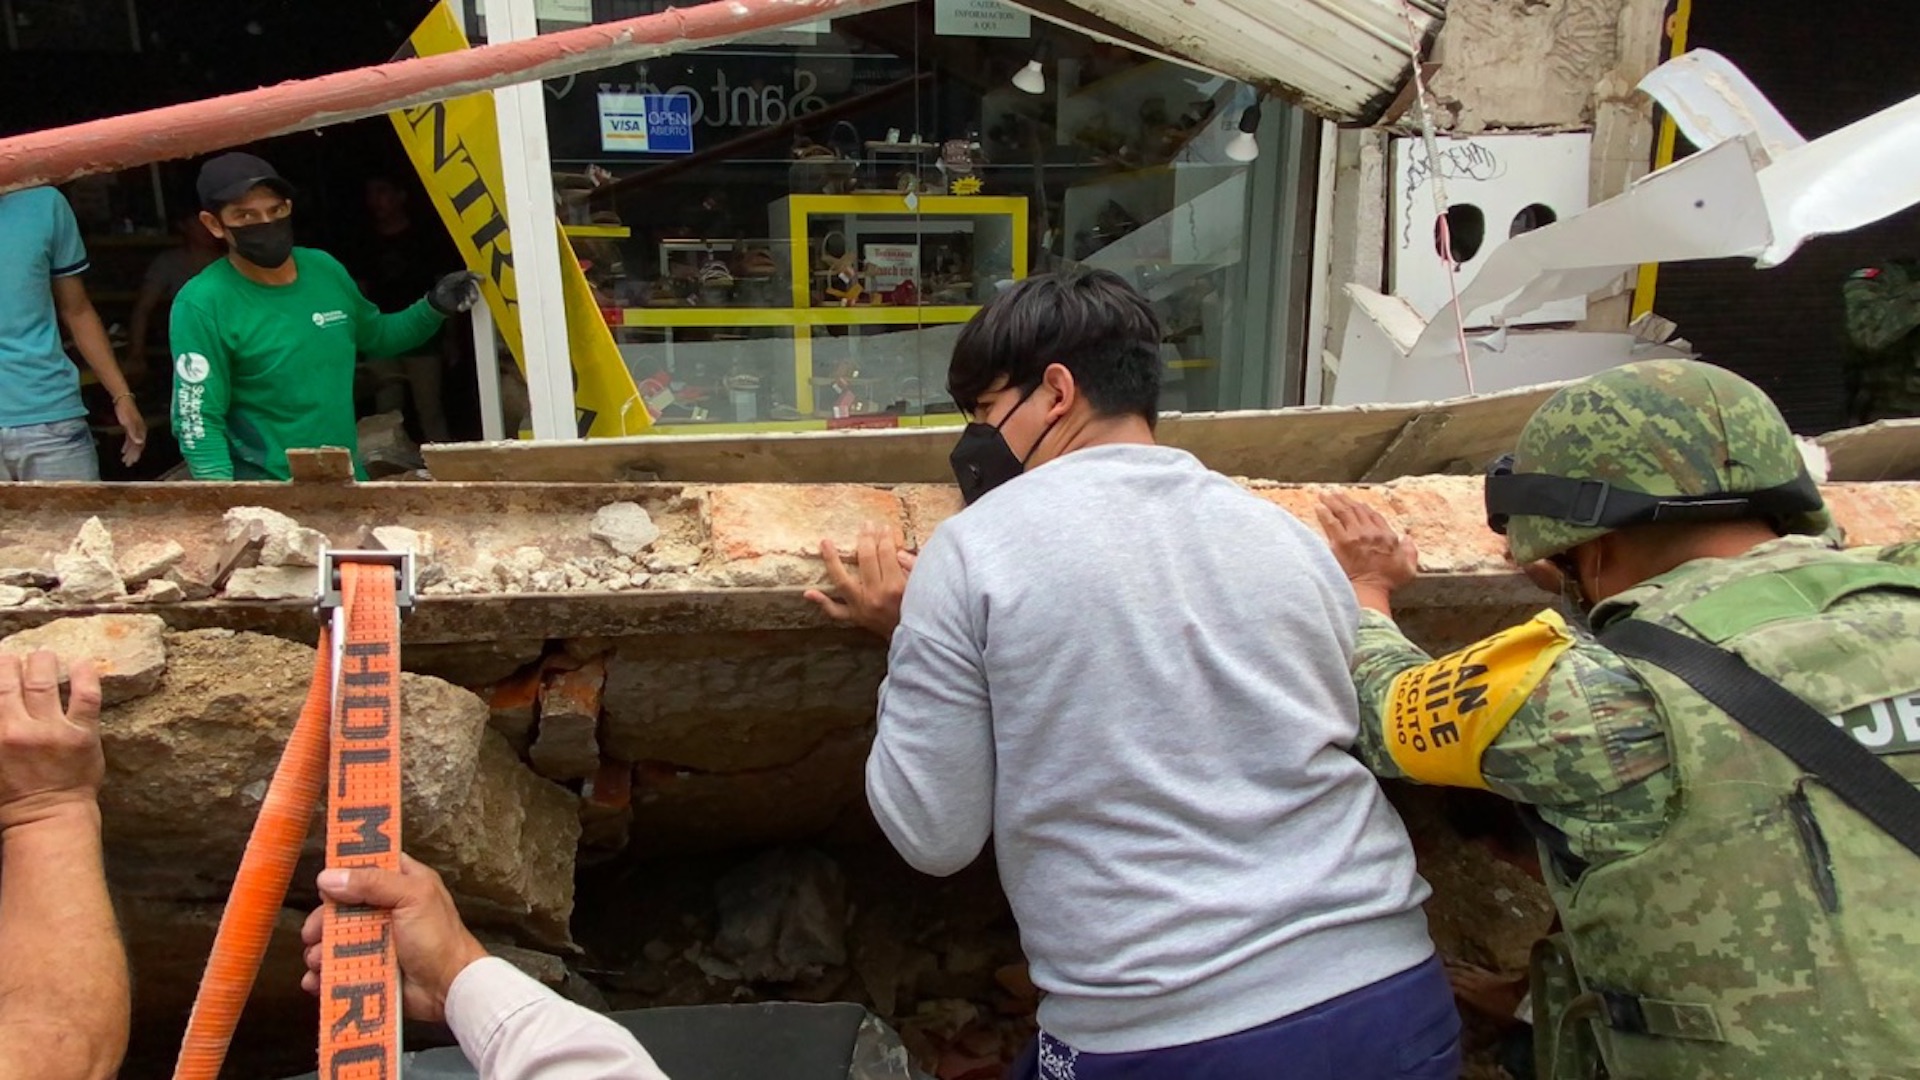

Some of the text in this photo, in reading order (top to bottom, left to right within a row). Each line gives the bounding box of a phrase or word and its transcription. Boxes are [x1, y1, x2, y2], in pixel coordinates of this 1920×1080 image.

[648, 111, 687, 125] OPEN
[610, 119, 640, 131] VISA
[649, 125, 688, 136] ABIERTO
